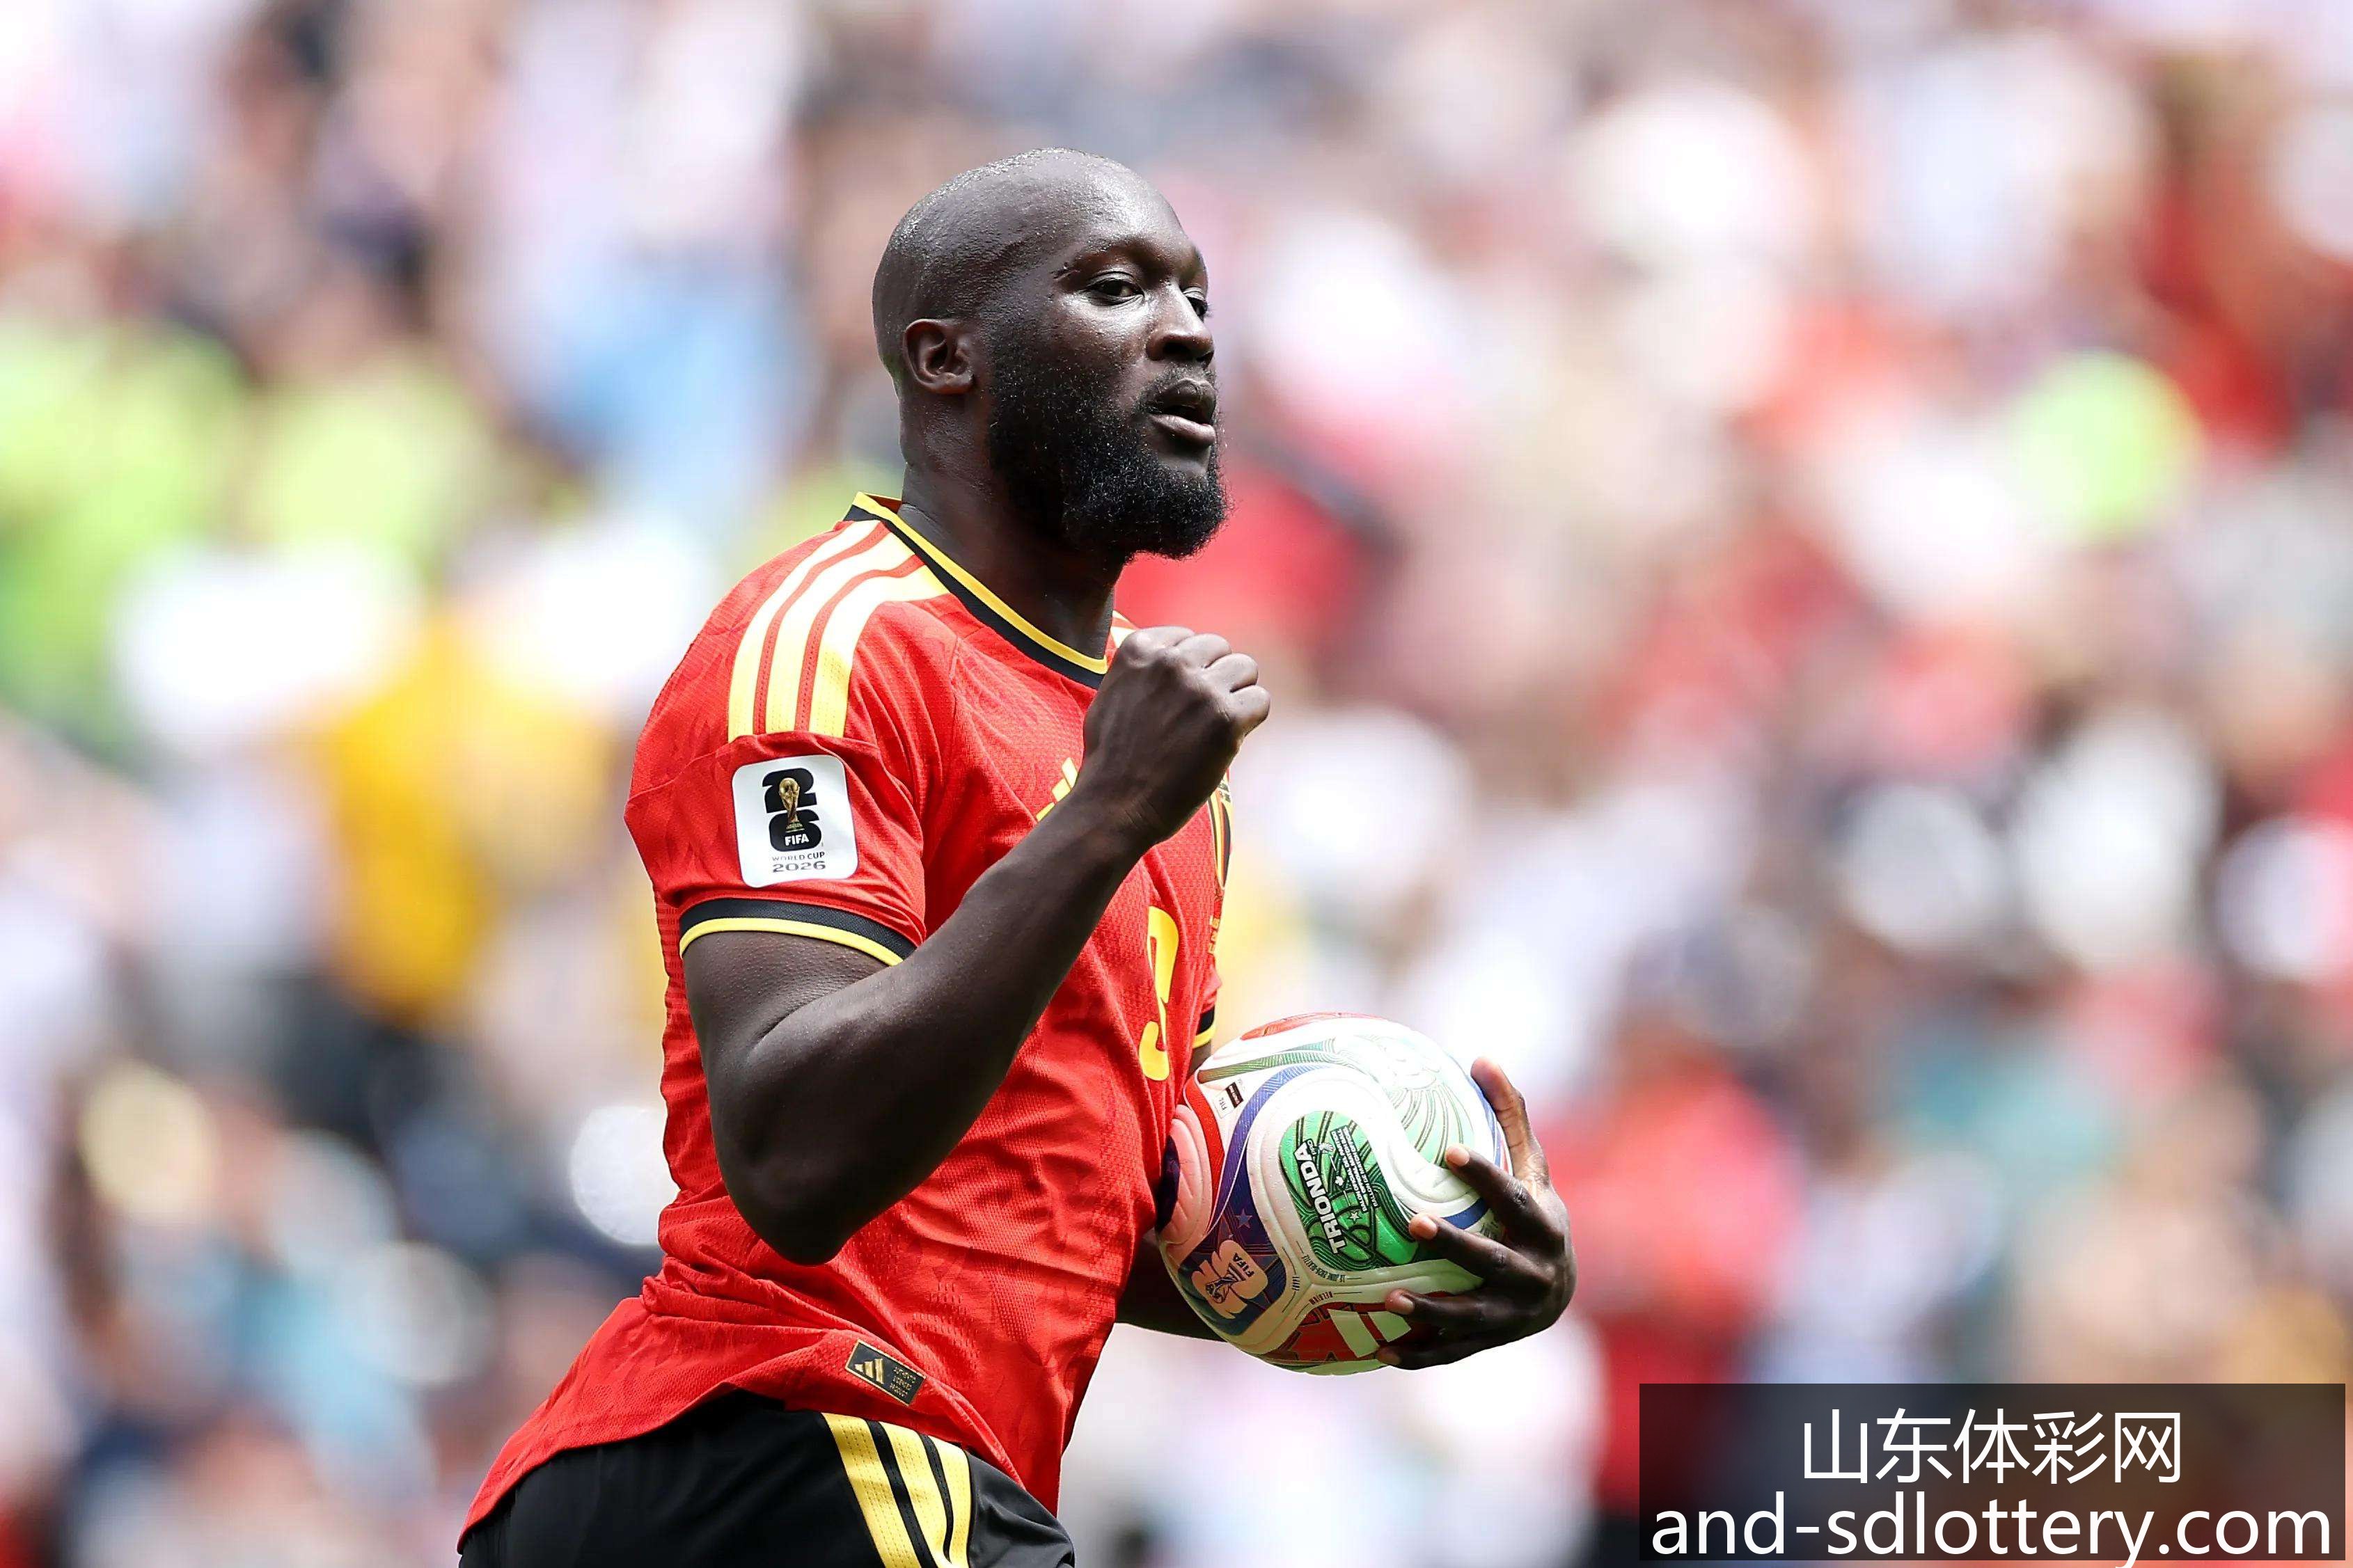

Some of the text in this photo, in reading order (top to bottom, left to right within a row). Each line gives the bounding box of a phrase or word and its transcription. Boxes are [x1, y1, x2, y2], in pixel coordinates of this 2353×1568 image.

[785, 834, 809, 846] FIFA
[808, 851, 825, 860] CUP
[773, 861, 826, 873] 2026
[1307, 1139, 1317, 1155] PRO
[1296, 1142, 1346, 1254] TRIONDA
[1233, 1253, 1254, 1277] FIFA
